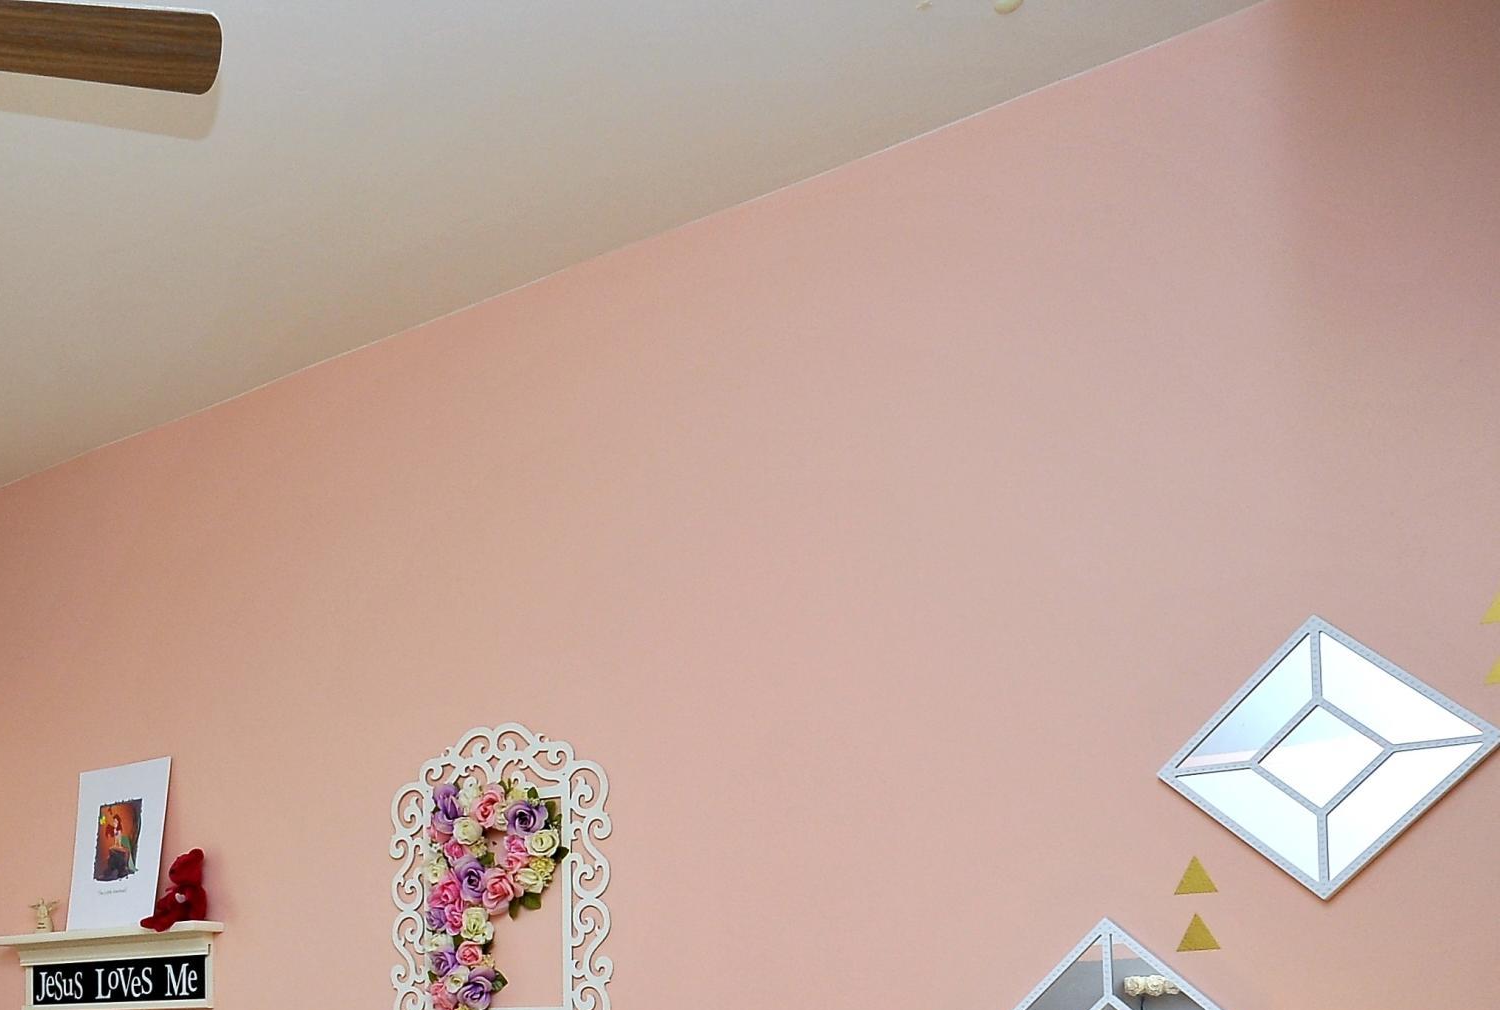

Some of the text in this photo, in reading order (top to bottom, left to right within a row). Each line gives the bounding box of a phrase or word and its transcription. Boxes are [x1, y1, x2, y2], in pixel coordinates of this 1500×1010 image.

[36, 963, 198, 1001] Jesus Loves Me
